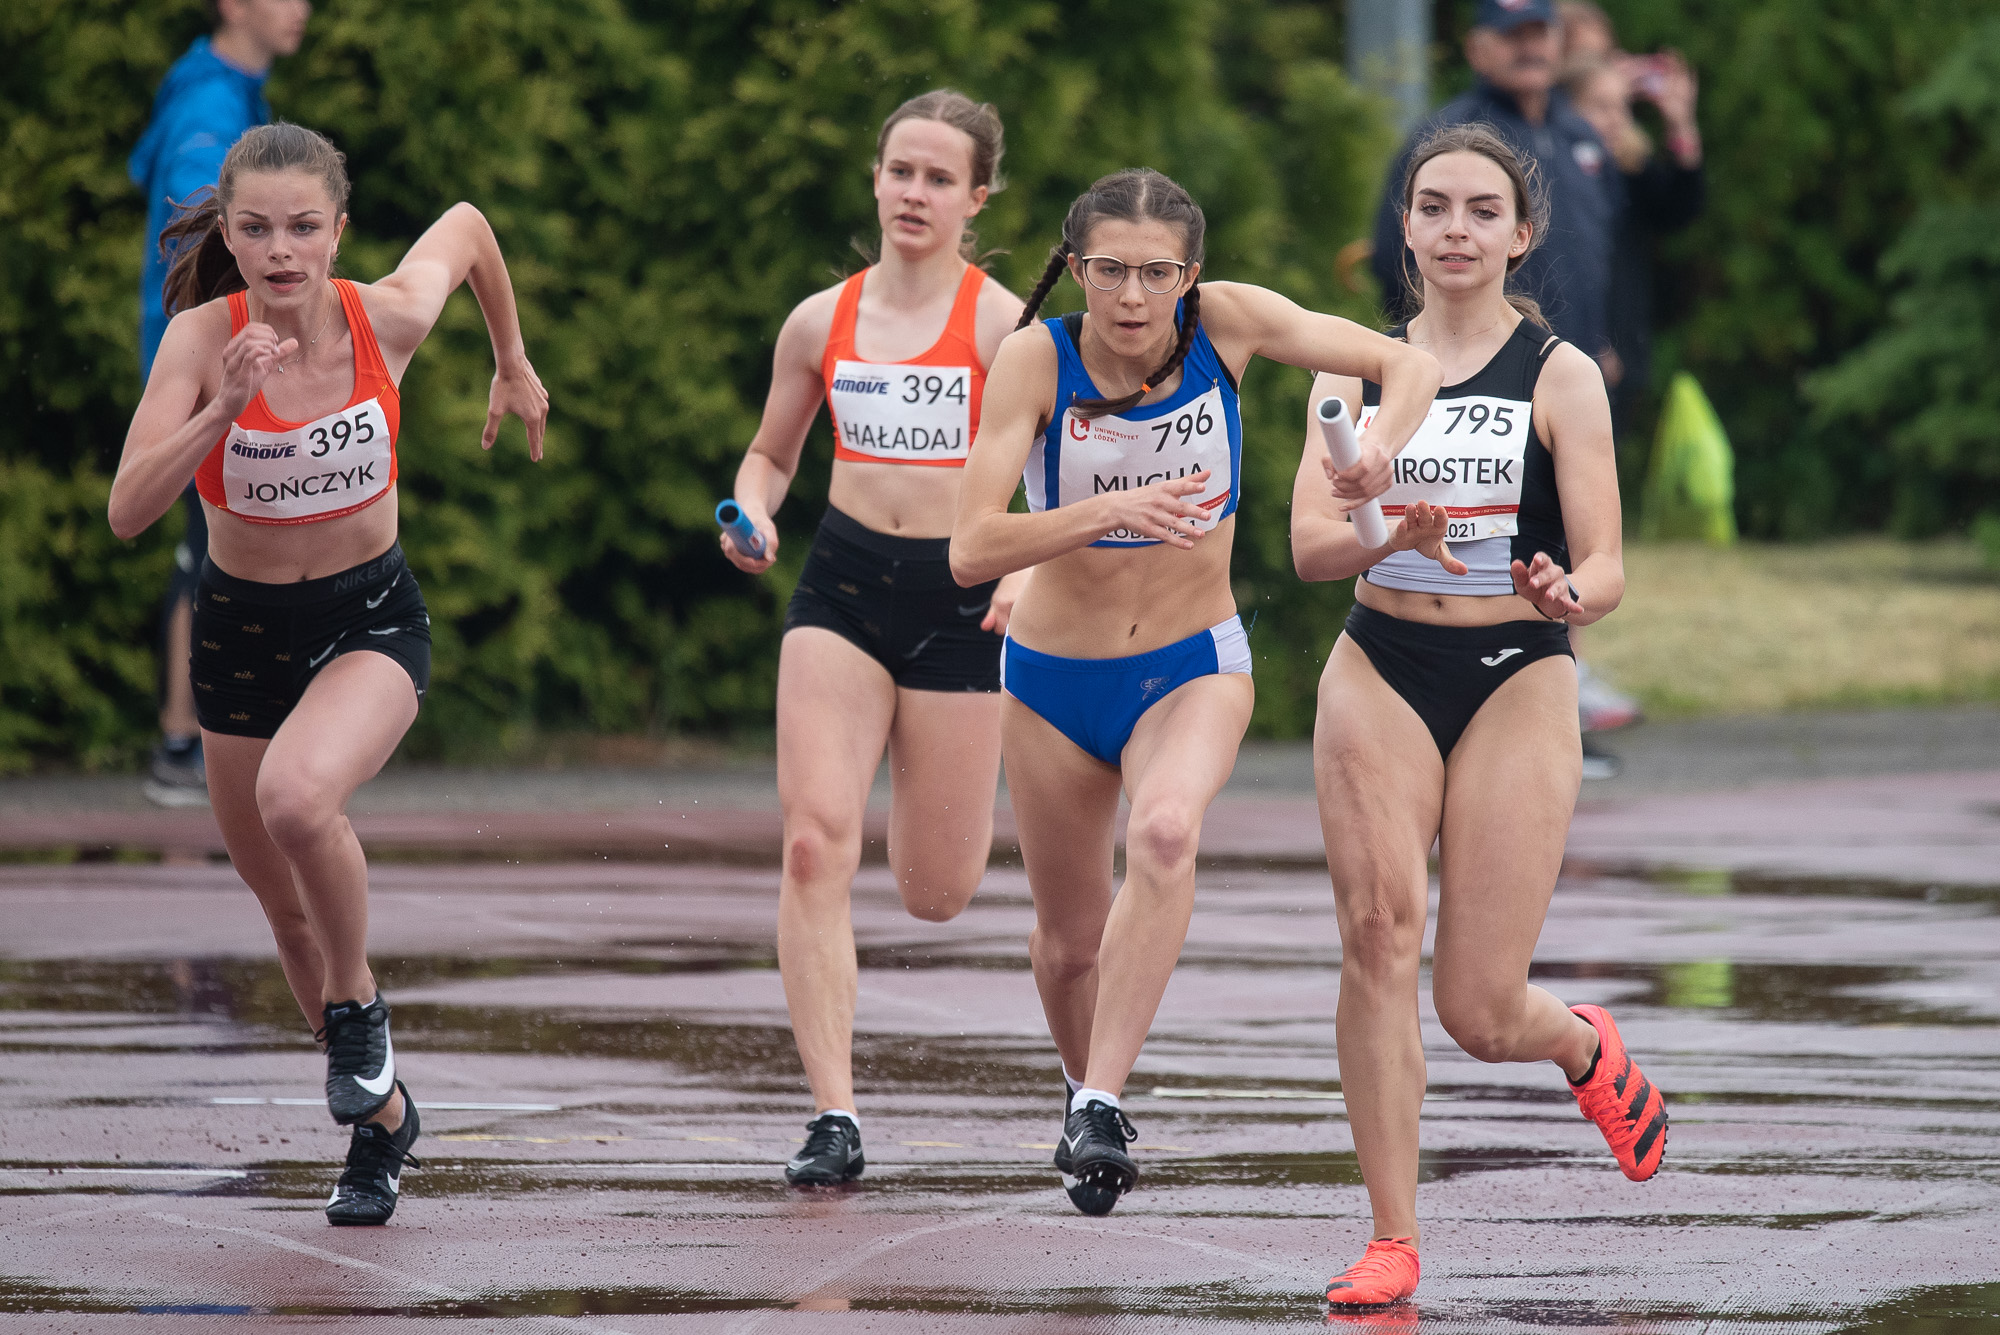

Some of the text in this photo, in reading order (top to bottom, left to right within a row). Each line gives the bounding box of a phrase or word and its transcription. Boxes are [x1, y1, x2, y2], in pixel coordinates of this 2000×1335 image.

[901, 374, 967, 406] 394
[308, 410, 375, 458] 395
[1094, 426, 1140, 440] UNIWERSYTET
[1151, 401, 1214, 454] 796
[1443, 403, 1514, 437] 795
[843, 421, 961, 451] HAŁADAJ
[1093, 433, 1117, 443] ŁÓDZKI
[243, 460, 376, 503] JOŃCZYK
[1444, 522, 1476, 538] 021
[333, 563, 379, 593] NIKE
[229, 711, 251, 721] nike
